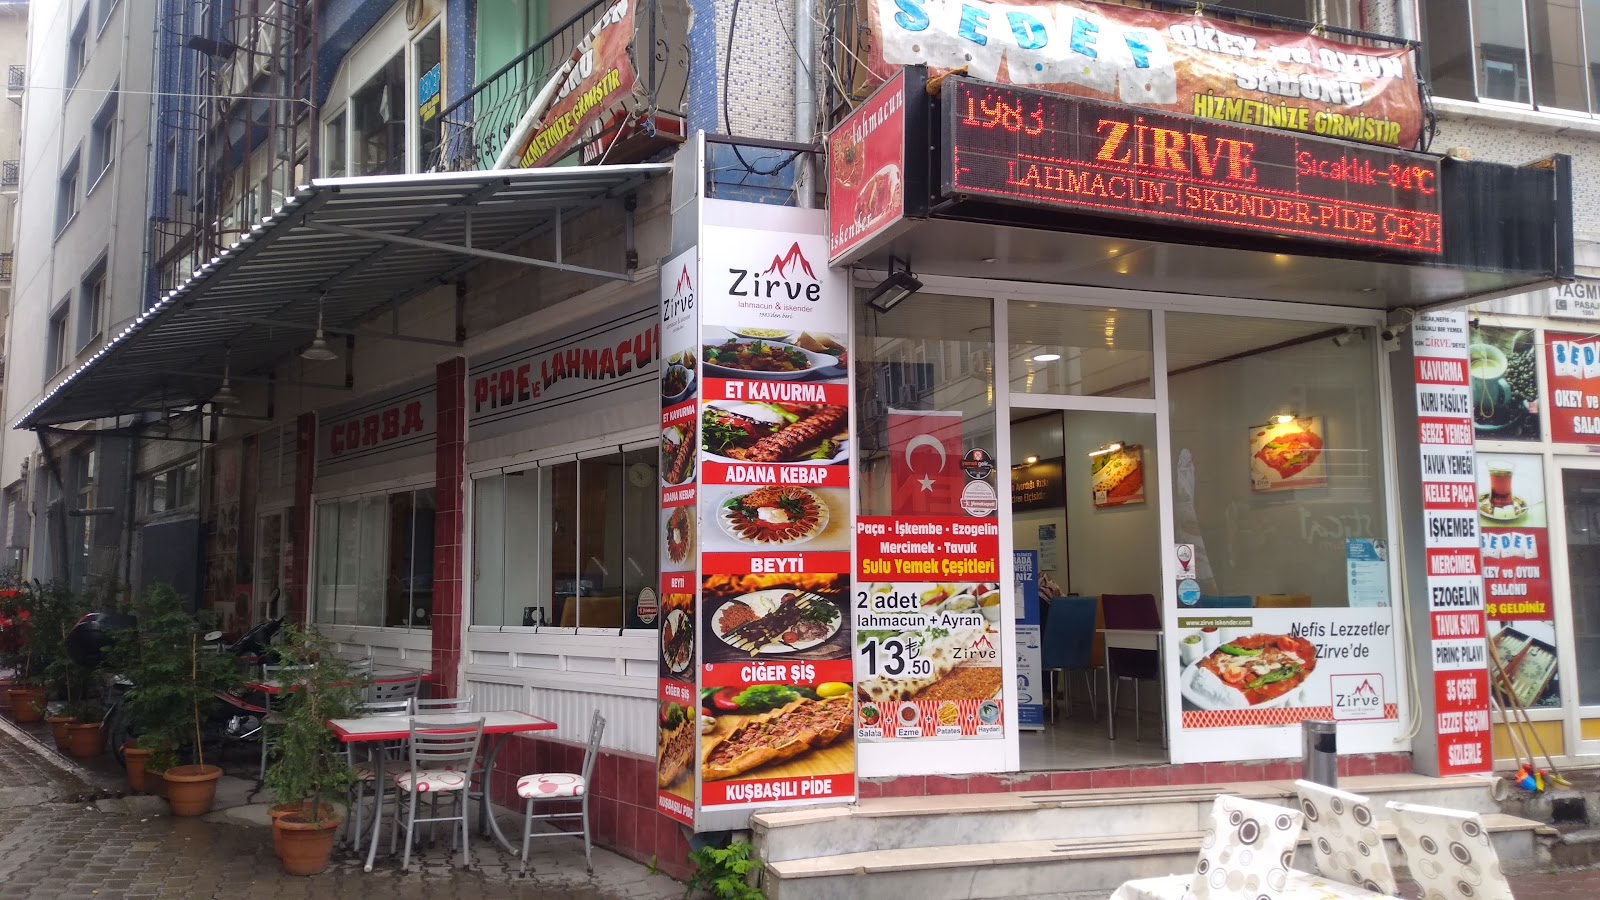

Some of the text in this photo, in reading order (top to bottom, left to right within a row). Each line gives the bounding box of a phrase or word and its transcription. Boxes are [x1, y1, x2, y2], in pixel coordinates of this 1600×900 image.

[894, 0, 1152, 69] SEDEF
[1169, 24, 1257, 58] OKEY
[1319, 48, 1403, 79] OYUN
[1235, 65, 1364, 107] SALONU
[852, 89, 902, 146] lahmacun
[962, 90, 1045, 136] 1983
[1194, 89, 1308, 131] HİZMETİNİZE
[1096, 117, 1257, 182] ZİRVE
[1382, 213, 1438, 246] ÇEŞİ
[729, 268, 820, 302] Zirve
[664, 293, 694, 322] Zirve
[738, 301, 813, 312] lahmacun & iskender
[1556, 343, 1600, 366] SED
[1420, 360, 1464, 382] KAVURMA
[473, 363, 531, 413] PİDE
[725, 381, 826, 402] ET KAVURMA
[1555, 389, 1599, 409] OKEY ve
[1420, 392, 1439, 412] KURU
[663, 404, 695, 423] ET KAVURMA
[1421, 419, 1472, 444] SEBZE YEMEĞİ
[1423, 450, 1473, 475] TAVUK YEMEĞİ
[725, 465, 828, 484] ADANA KEBAP
[663, 488, 695, 503] ADANA KEBAP
[1424, 484, 1475, 507] KELLE PAÇA
[857, 521, 885, 536] Paça
[895, 521, 943, 537] İşkembe
[952, 523, 998, 537] Ezogelin
[1429, 512, 1476, 542] İŞKEMBE
[880, 541, 935, 554] Mercimek
[944, 542, 977, 554] Tavuk
[751, 553, 804, 573] BEYTİ
[862, 558, 995, 576] Sulu Yemek Çeşitleri
[1431, 549, 1477, 574] MERCİMEK
[1483, 566, 1540, 579] KEY ve OYUN
[671, 574, 685, 588] BEYTİ
[1490, 583, 1527, 596] SALONU
[857, 591, 918, 609] 2 adet
[1432, 580, 1480, 607] EZOGELİN
[1486, 600, 1546, 617] OŞ GELDİNİZ
[857, 614, 925, 627] lahmacun
[941, 614, 981, 629] Ayran
[1290, 621, 1391, 638] Nefis Lezzetler
[1435, 613, 1480, 636] TAVUK SUYU
[952, 647, 996, 659] Zirve
[1314, 643, 1370, 659] Zirve'de
[1461, 641, 1484, 663] PİLAVI
[790, 660, 816, 687] ŞİŞ
[680, 684, 690, 701] ŞİŞ
[1446, 672, 1477, 705] 35 ÇEŞİT
[1336, 694, 1379, 707] Zirve
[858, 729, 882, 738] Salata
[936, 727, 961, 735] Patates
[1437, 711, 1463, 735] LEZZET
[1448, 739, 1482, 767] SİZLERLE
[726, 776, 832, 803] KUŞBAŞILI PİDE
[659, 795, 694, 819] KUŞBAŞILI PİDE
